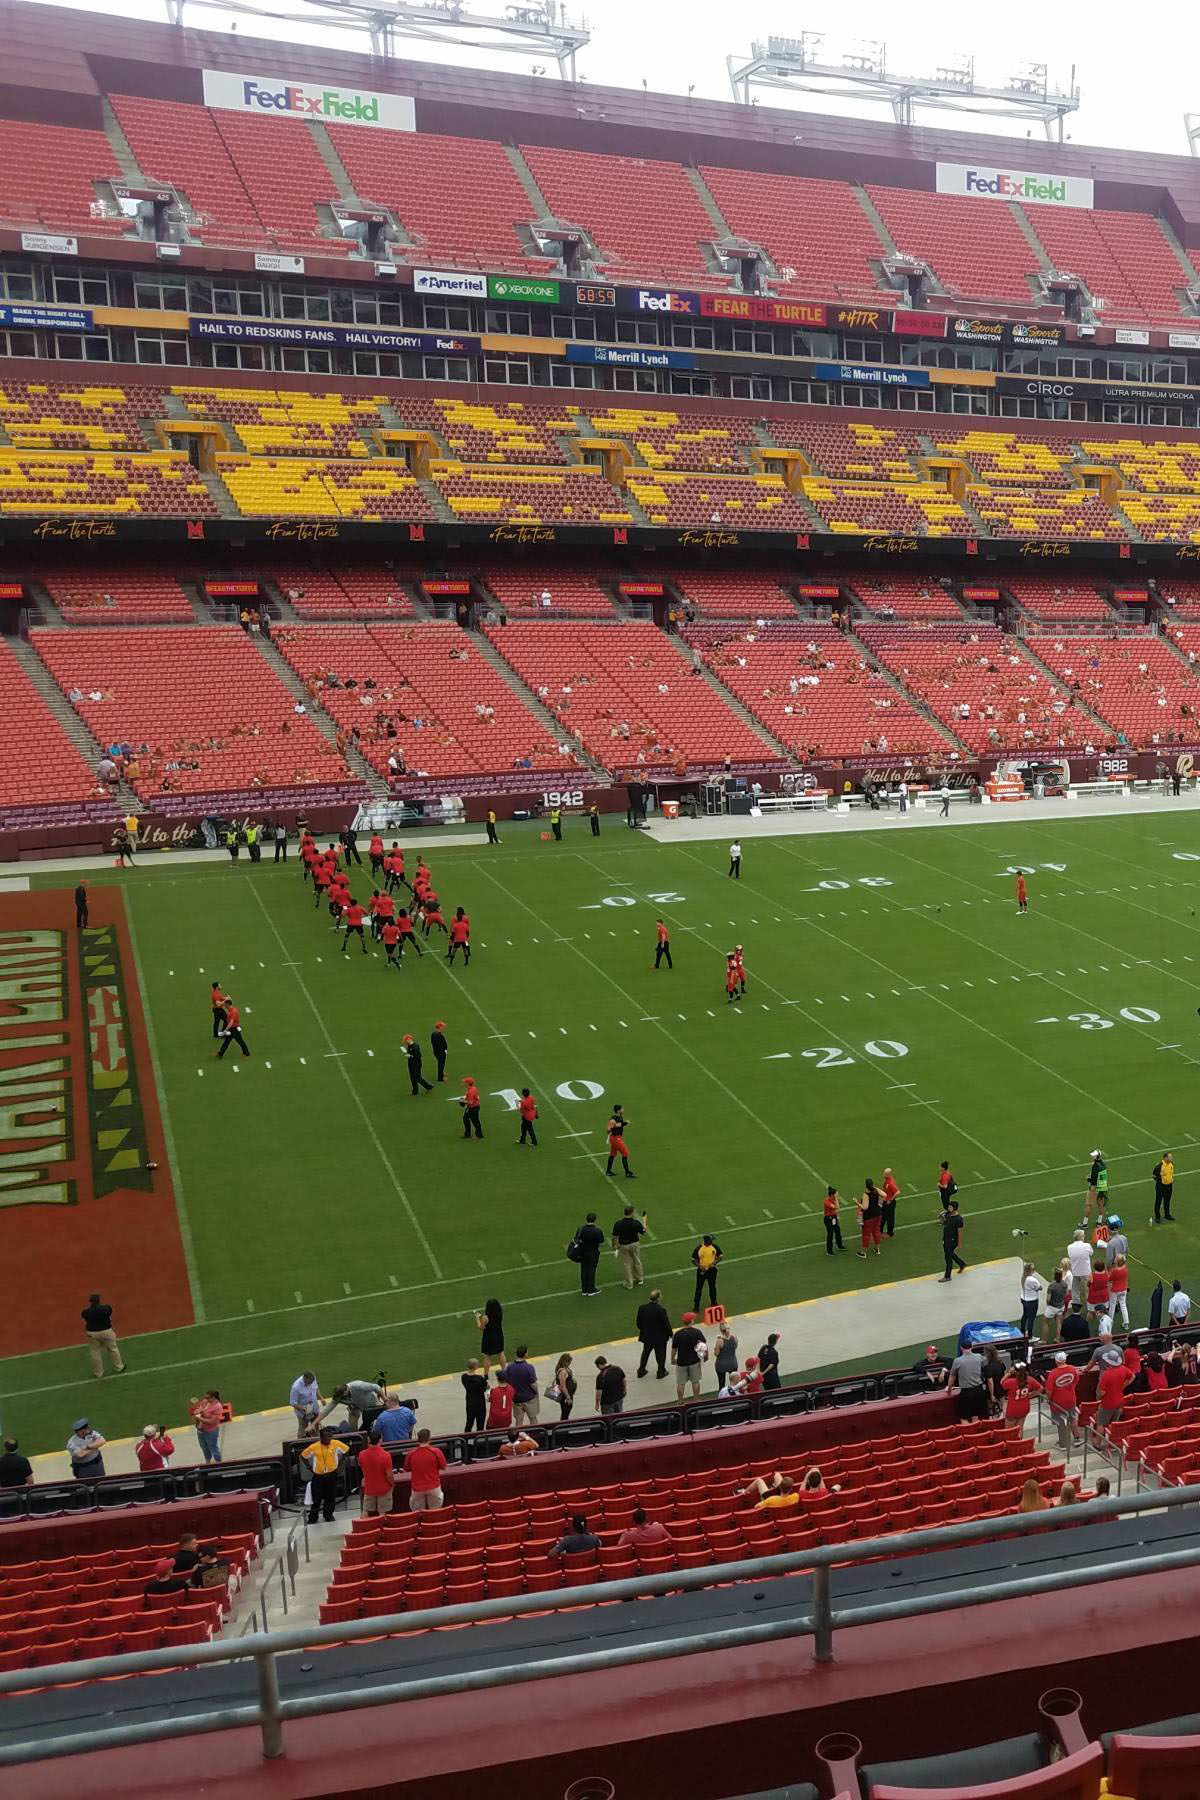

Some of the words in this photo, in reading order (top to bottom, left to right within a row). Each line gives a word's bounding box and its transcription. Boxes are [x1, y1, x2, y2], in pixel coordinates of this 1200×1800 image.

[243, 81, 379, 122] FedExField
[966, 170, 1066, 201] FedExField
[429, 276, 484, 291] Ameritel
[508, 286, 533, 295] XBOX
[533, 287, 554, 297] ONE
[639, 291, 692, 313] FedEx
[37, 318, 86, 327] RESPONSIBLY
[970, 320, 1004, 333] Sports
[199, 323, 227, 335] HAIL
[227, 325, 243, 336] TO
[245, 326, 302, 339] REDSKINS
[305, 330, 337, 342] FANS.
[345, 333, 371, 344] HAIL
[371, 334, 421, 348] VICTORY!
[956, 331, 1001, 341] WASHINGTON
[1027, 325, 1061, 338] Sports
[436, 339, 464, 350] FedEx
[1013, 336, 1058, 346] WASHINGTON
[608, 350, 640, 363] Merrill
[641, 352, 669, 365] Lynch
[853, 369, 880, 381] Merrill
[883, 371, 908, 383] Lynch
[1105, 389, 1130, 397] ULTRA
[1131, 390, 1167, 398] PREMIUM
[1168, 391, 1195, 400] VODKA
[1098, 759, 1128, 772] 1982
[864, 768, 888, 782] Hail
[889, 770, 900, 781] to
[903, 768, 921, 781] the
[542, 791, 584, 807] 1942
[669, 806, 676, 814] G
[152, 827, 168, 842] to
[172, 823, 198, 842] the
[1065, 1005, 1162, 1031] 30
[801, 1039, 910, 1069] 20
[705, 1306, 725, 1324] 10
